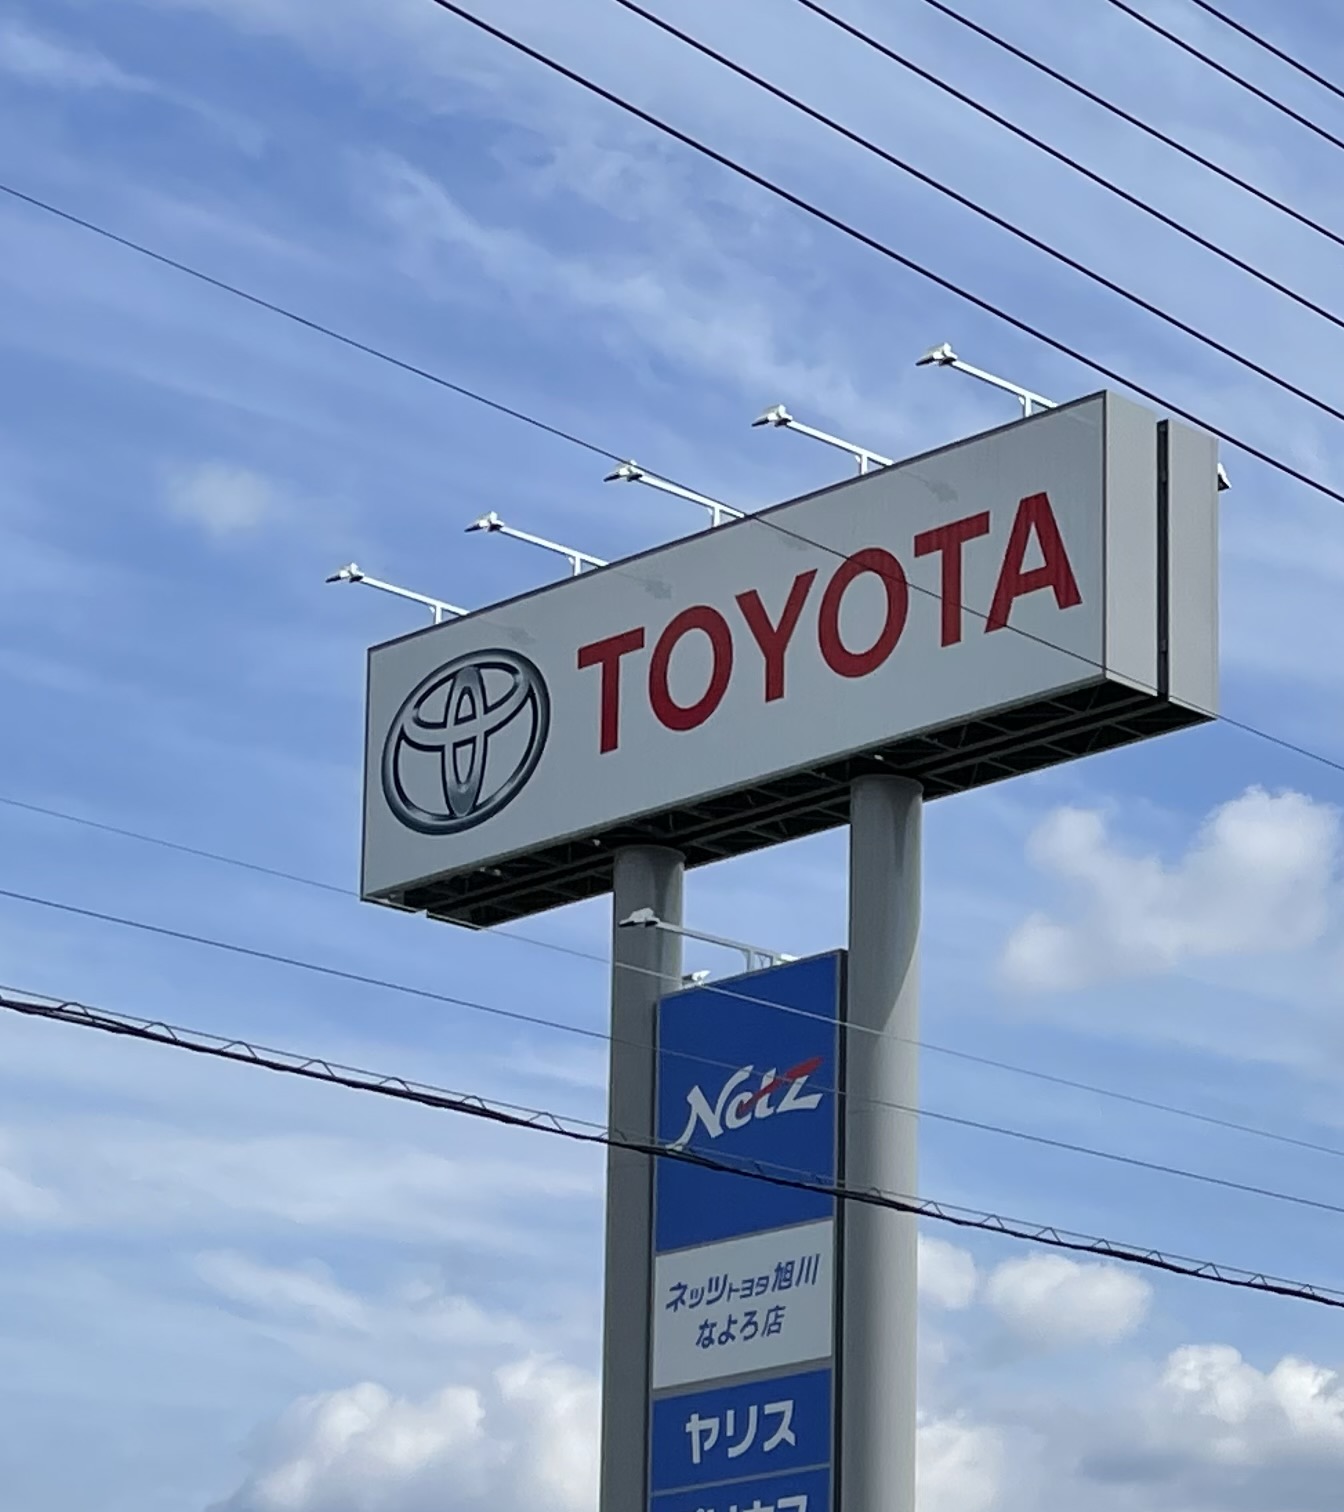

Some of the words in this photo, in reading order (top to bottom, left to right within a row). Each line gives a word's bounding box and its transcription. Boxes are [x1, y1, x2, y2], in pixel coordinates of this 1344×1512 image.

[577, 492, 1083, 754] TOYOTA
[666, 1056, 824, 1152] Netz
[666, 1253, 820, 1312] ネッツトヨタ旭川
[695, 1305, 786, 1349] なよろ店
[685, 1399, 796, 1464] ヤリス
